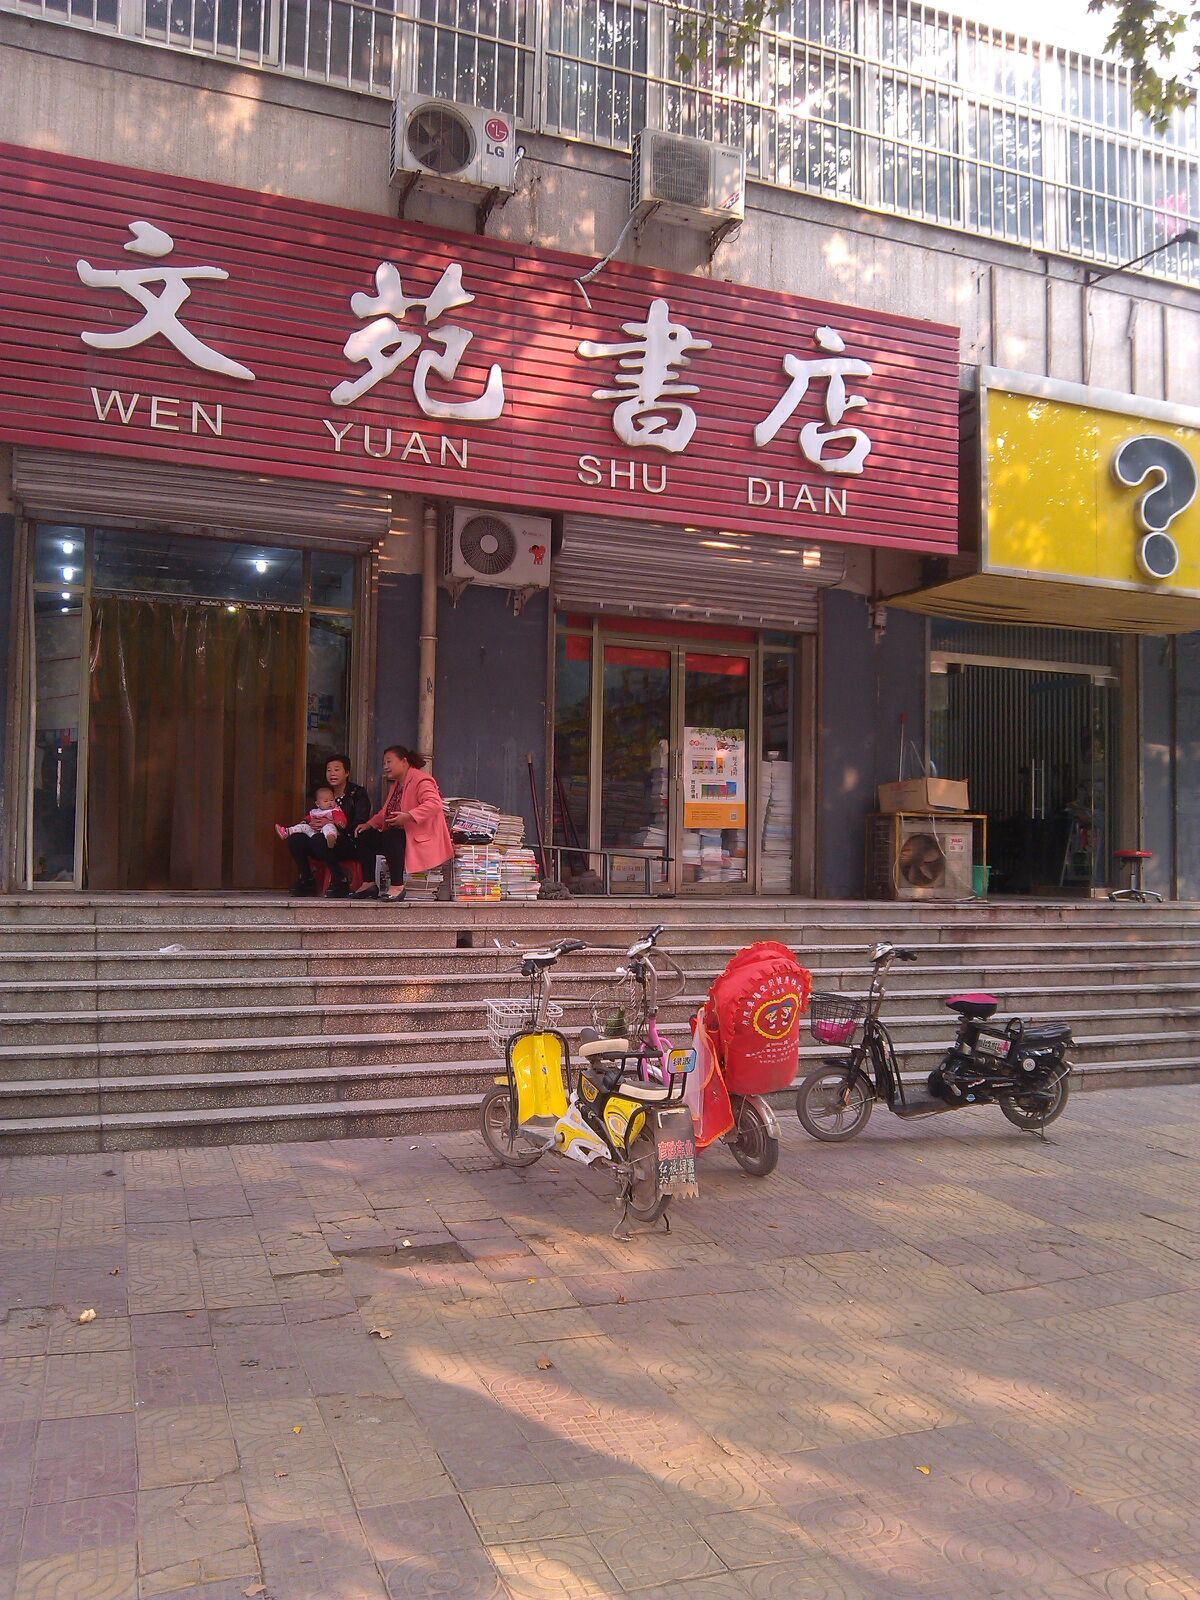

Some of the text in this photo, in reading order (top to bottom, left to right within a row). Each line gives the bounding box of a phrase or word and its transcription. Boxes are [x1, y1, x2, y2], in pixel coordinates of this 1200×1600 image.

[486, 143, 505, 158] LG
[90, 386, 848, 517] WEN YUAN SHU DIAN
[1112, 434, 1199, 579] ?
